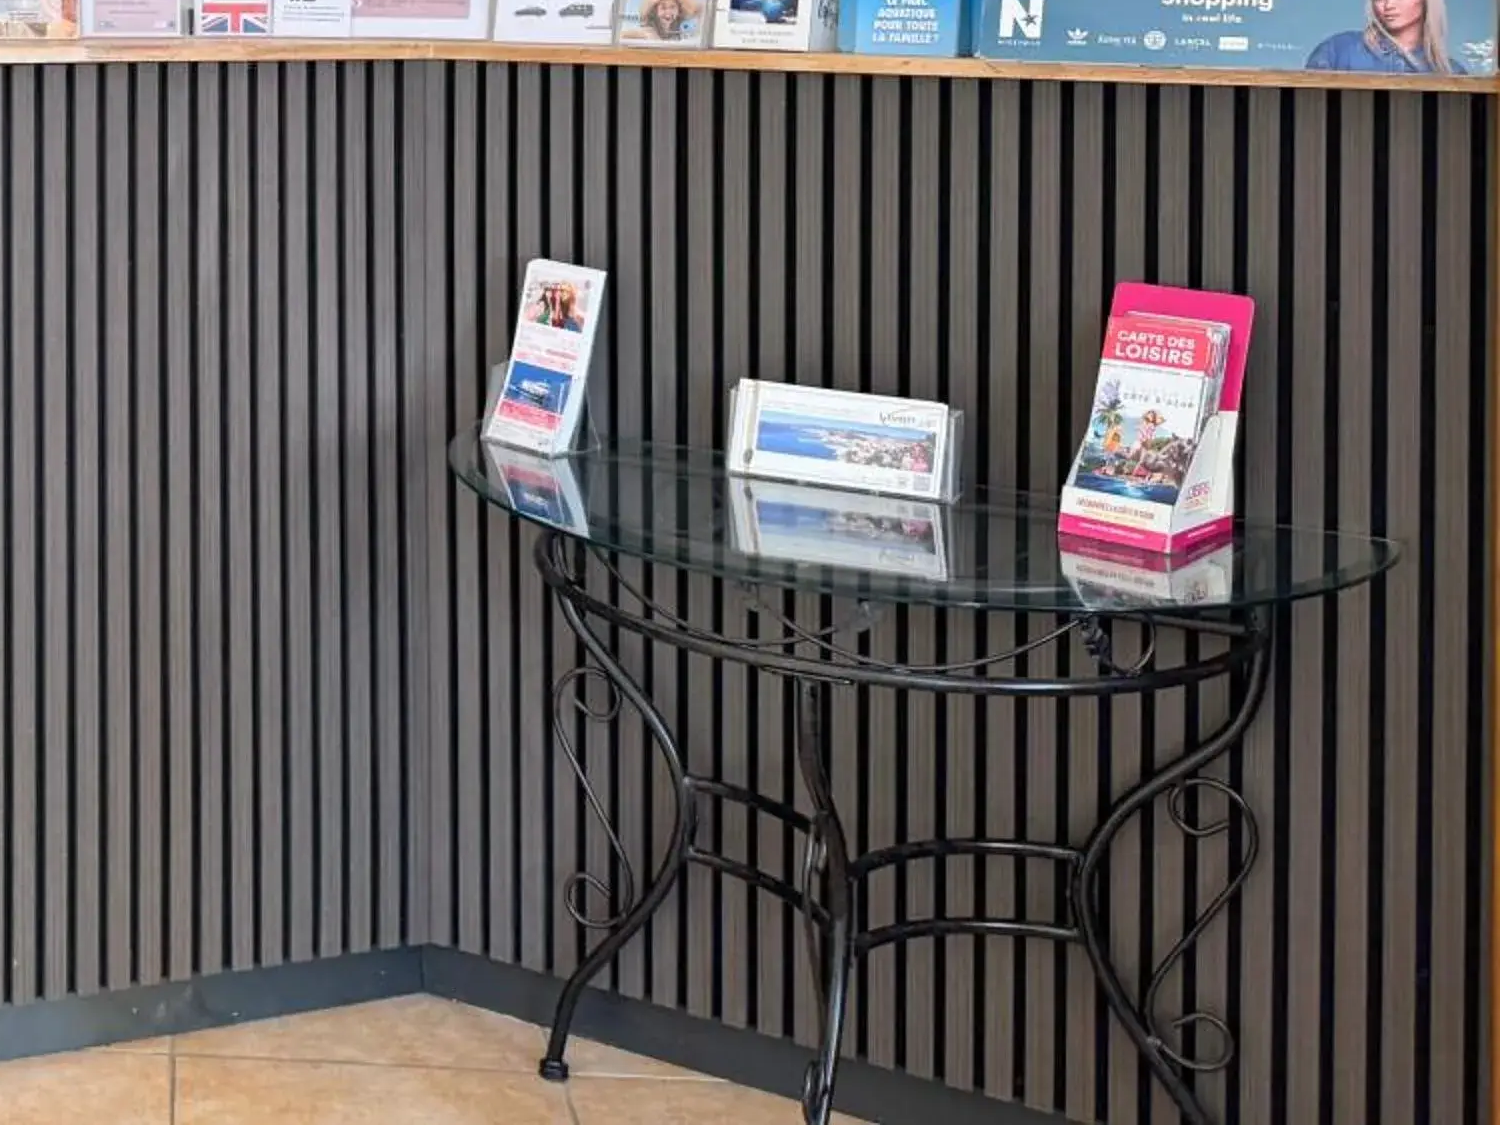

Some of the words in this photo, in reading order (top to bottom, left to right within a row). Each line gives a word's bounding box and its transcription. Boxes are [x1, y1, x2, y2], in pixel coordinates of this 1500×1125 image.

[873, 20, 904, 31] POUR
[872, 33, 887, 43] LA
[1117, 329, 1165, 347] CARTE
[1167, 336, 1195, 350] DES
[1114, 342, 1195, 366] LOISIRS
